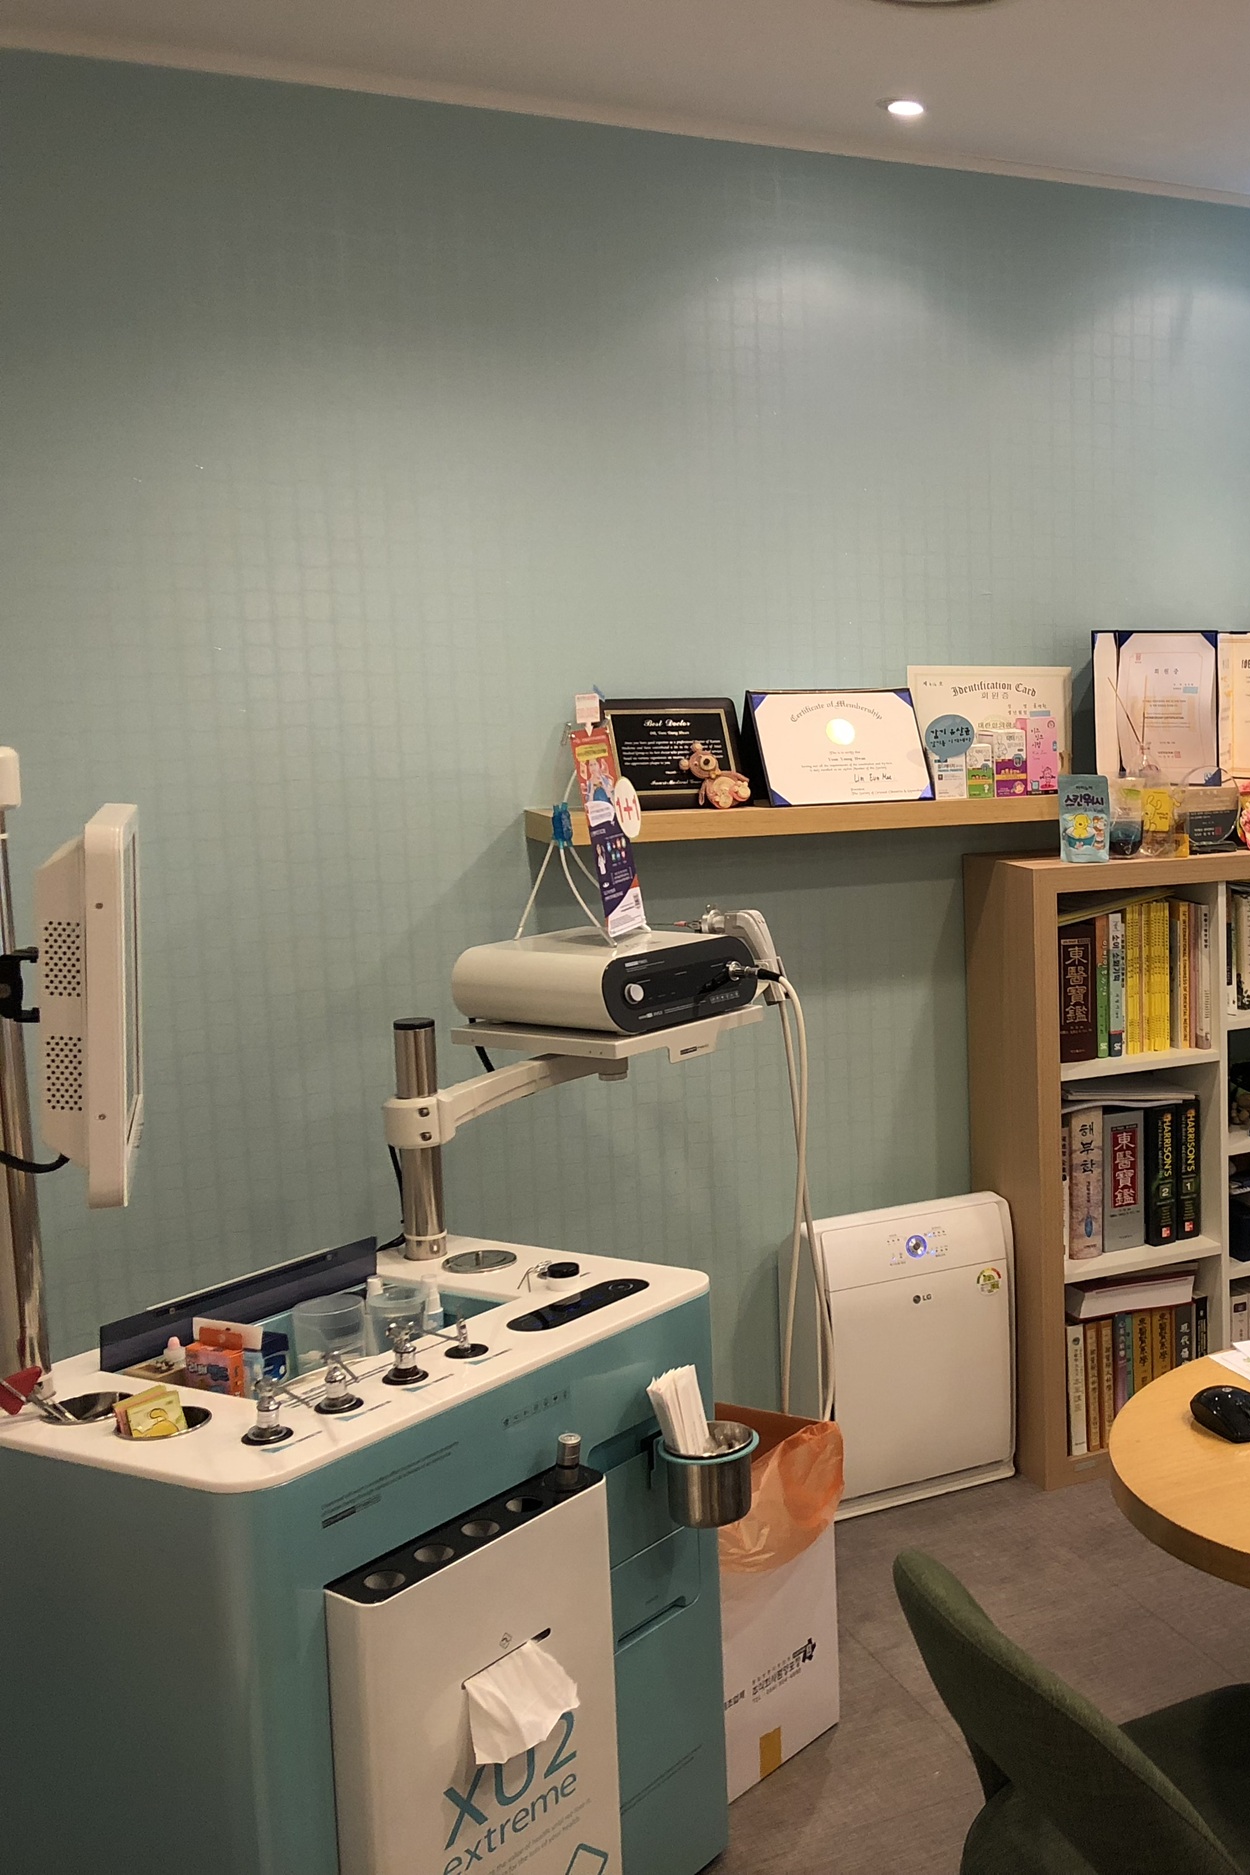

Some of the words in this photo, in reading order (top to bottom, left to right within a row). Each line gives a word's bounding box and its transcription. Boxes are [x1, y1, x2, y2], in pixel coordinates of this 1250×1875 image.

[790, 702, 824, 722] Certificate
[834, 700, 882, 720] Membership
[951, 681, 1012, 697] Identification
[1015, 682, 1036, 697] Card
[616, 796, 640, 824] 1+1
[1064, 792, 1104, 808] 스킨워시
[1066, 946, 1088, 1022] 東醫寶鑑
[1079, 1122, 1096, 1174] 해부학
[1114, 1132, 1136, 1206] 東醫寶鑑
[1164, 1117, 1172, 1177] HARRISON'S
[1187, 1114, 1196, 1172] HARRISON'S
[1162, 1188, 1169, 1197] 2
[1186, 1182, 1191, 1190] 1
[443, 1711, 577, 1850] XU2
[443, 1773, 577, 1875] extreme
